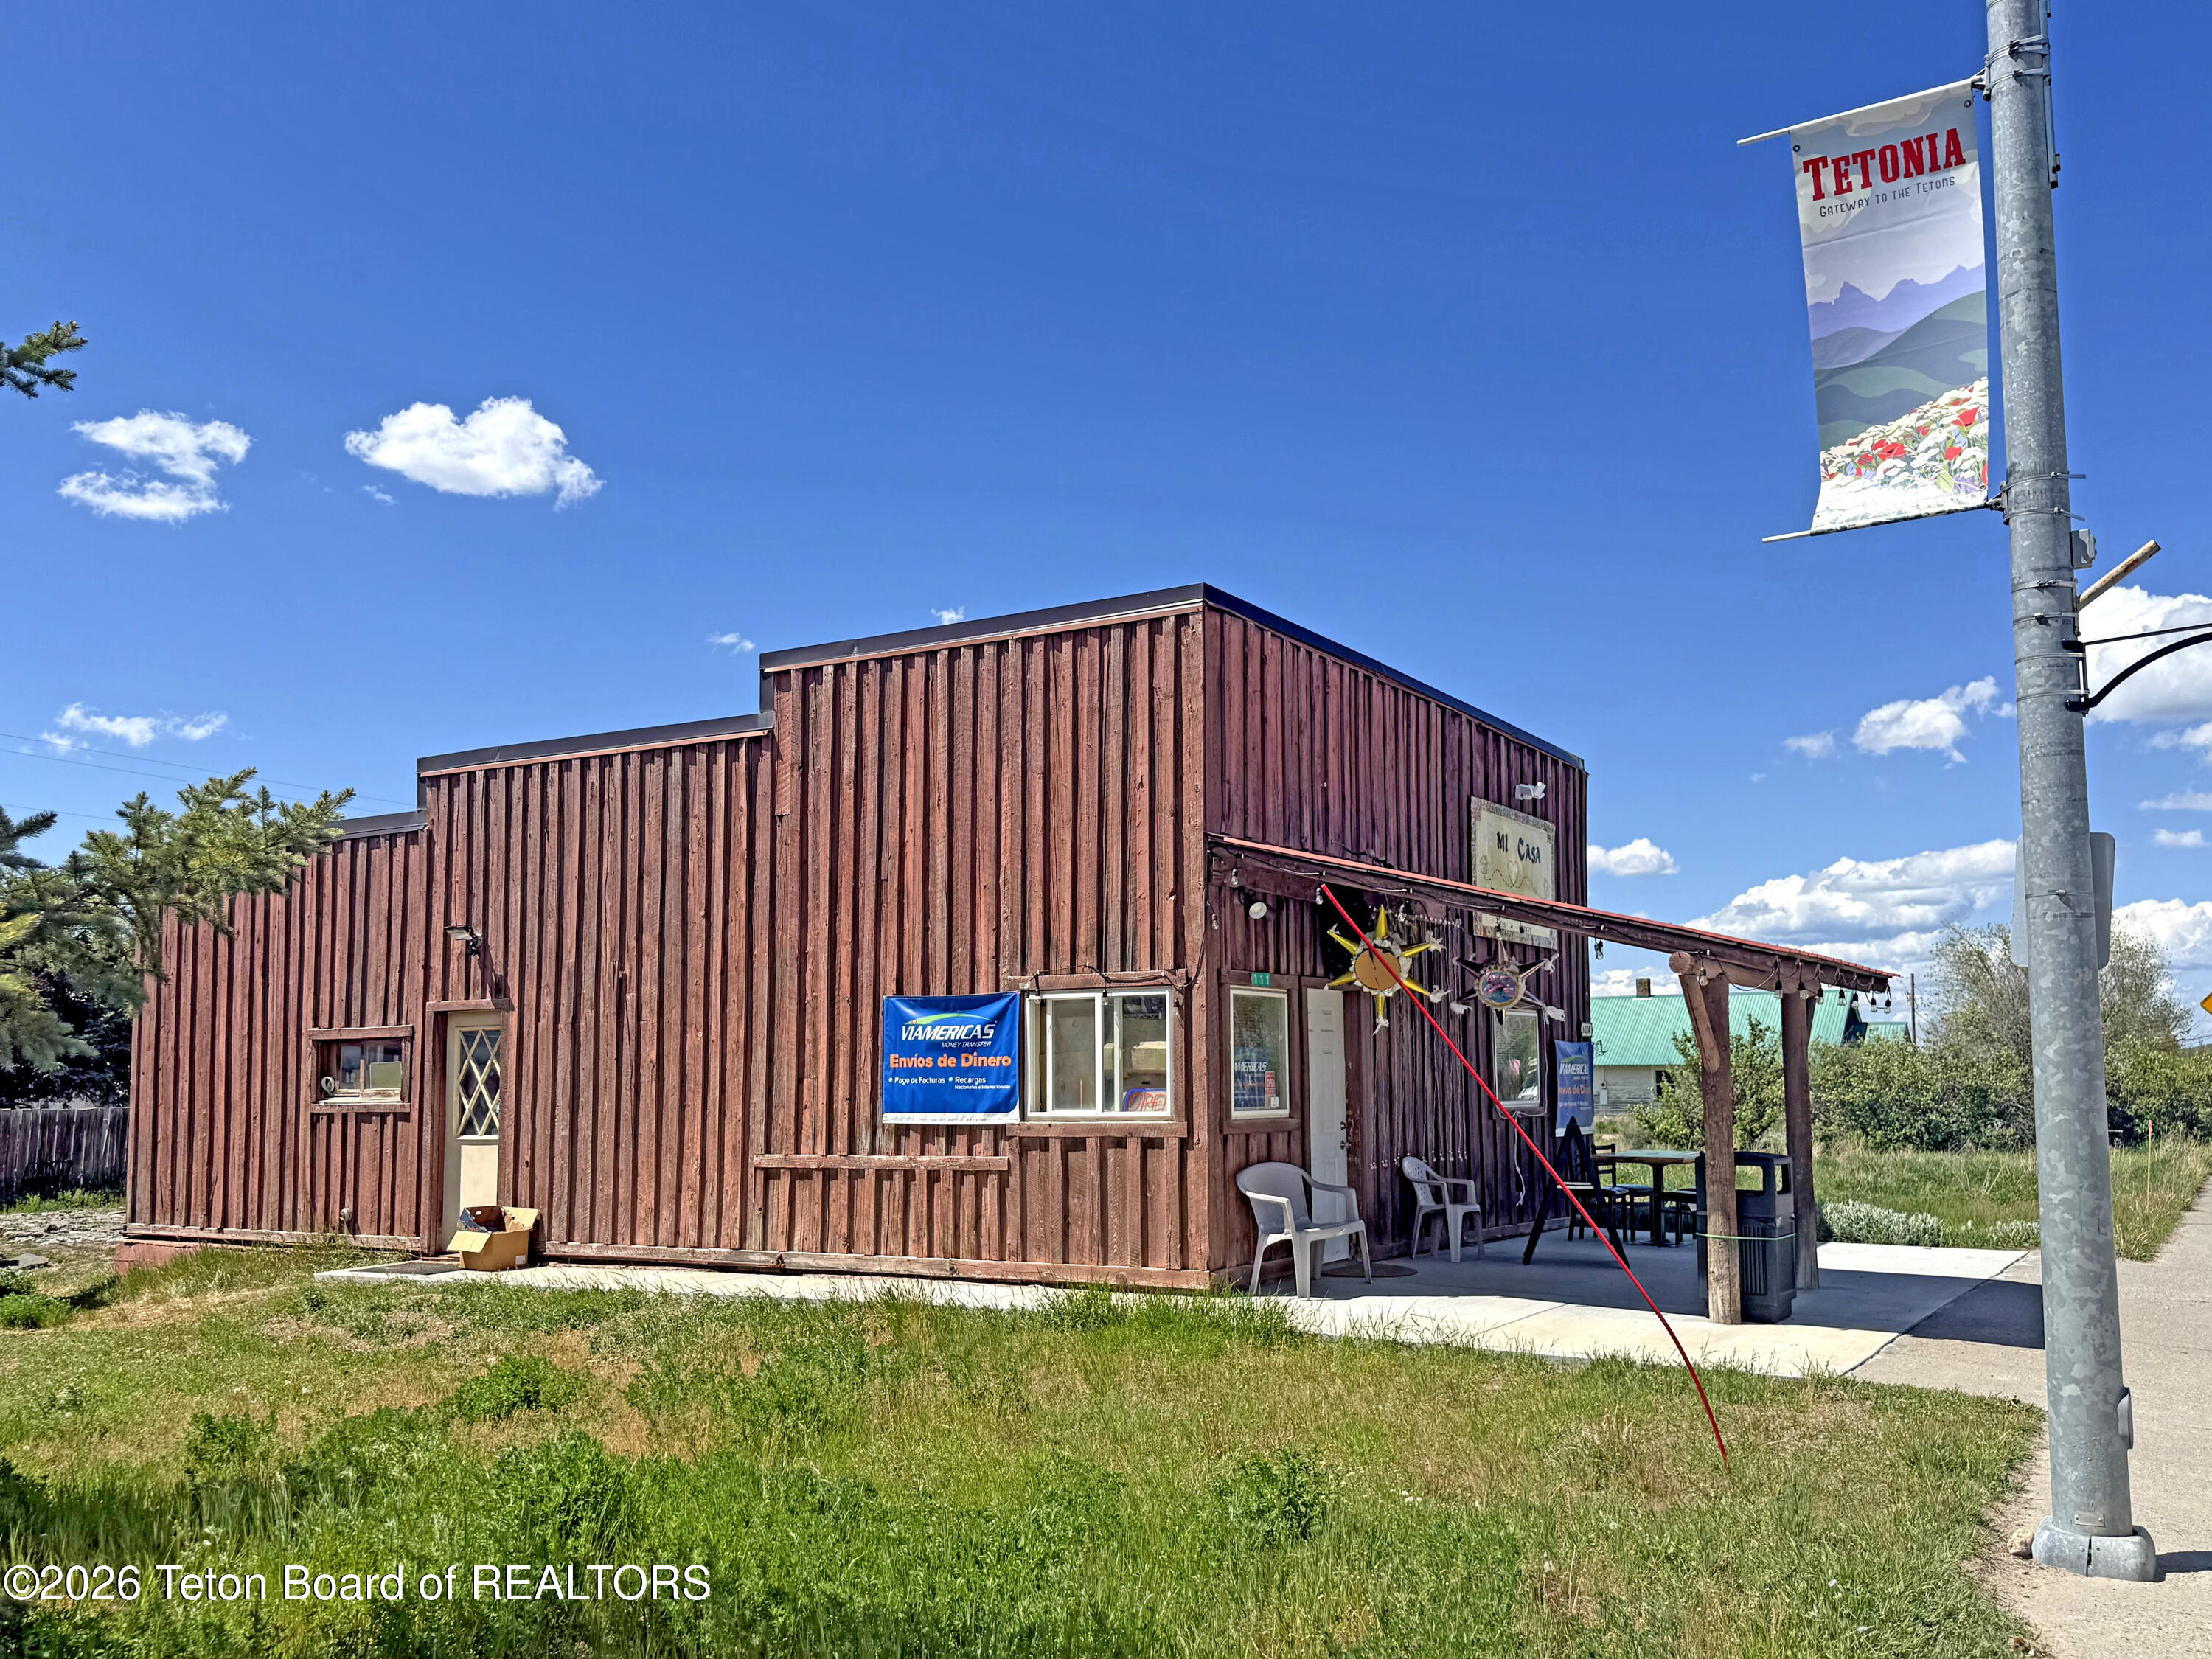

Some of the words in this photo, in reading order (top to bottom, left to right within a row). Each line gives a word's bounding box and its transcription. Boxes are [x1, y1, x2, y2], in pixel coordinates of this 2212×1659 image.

[1803, 128, 1966, 201] TETONIA
[1820, 197, 1871, 218] GATEWAY
[1875, 193, 1888, 204] TO
[1892, 187, 1910, 201] THE
[1915, 176, 1955, 195] TETONS
[1496, 831, 1509, 853] MI
[1517, 837, 1541, 864] CASA
[1253, 973, 1270, 986] 111
[902, 1023, 996, 1041] VIAMERICAS
[889, 1053, 933, 1068] Envíos
[937, 1053, 958, 1068] de
[961, 1051, 1012, 1068] Dinero
[1234, 1061, 1267, 1072] AMERICAS
[1559, 1063, 1589, 1074] VIAMERICA
[894, 1077, 910, 1085] Pago
[955, 1077, 987, 1085] Recargas
[1128, 1092, 1166, 1111] OPE
